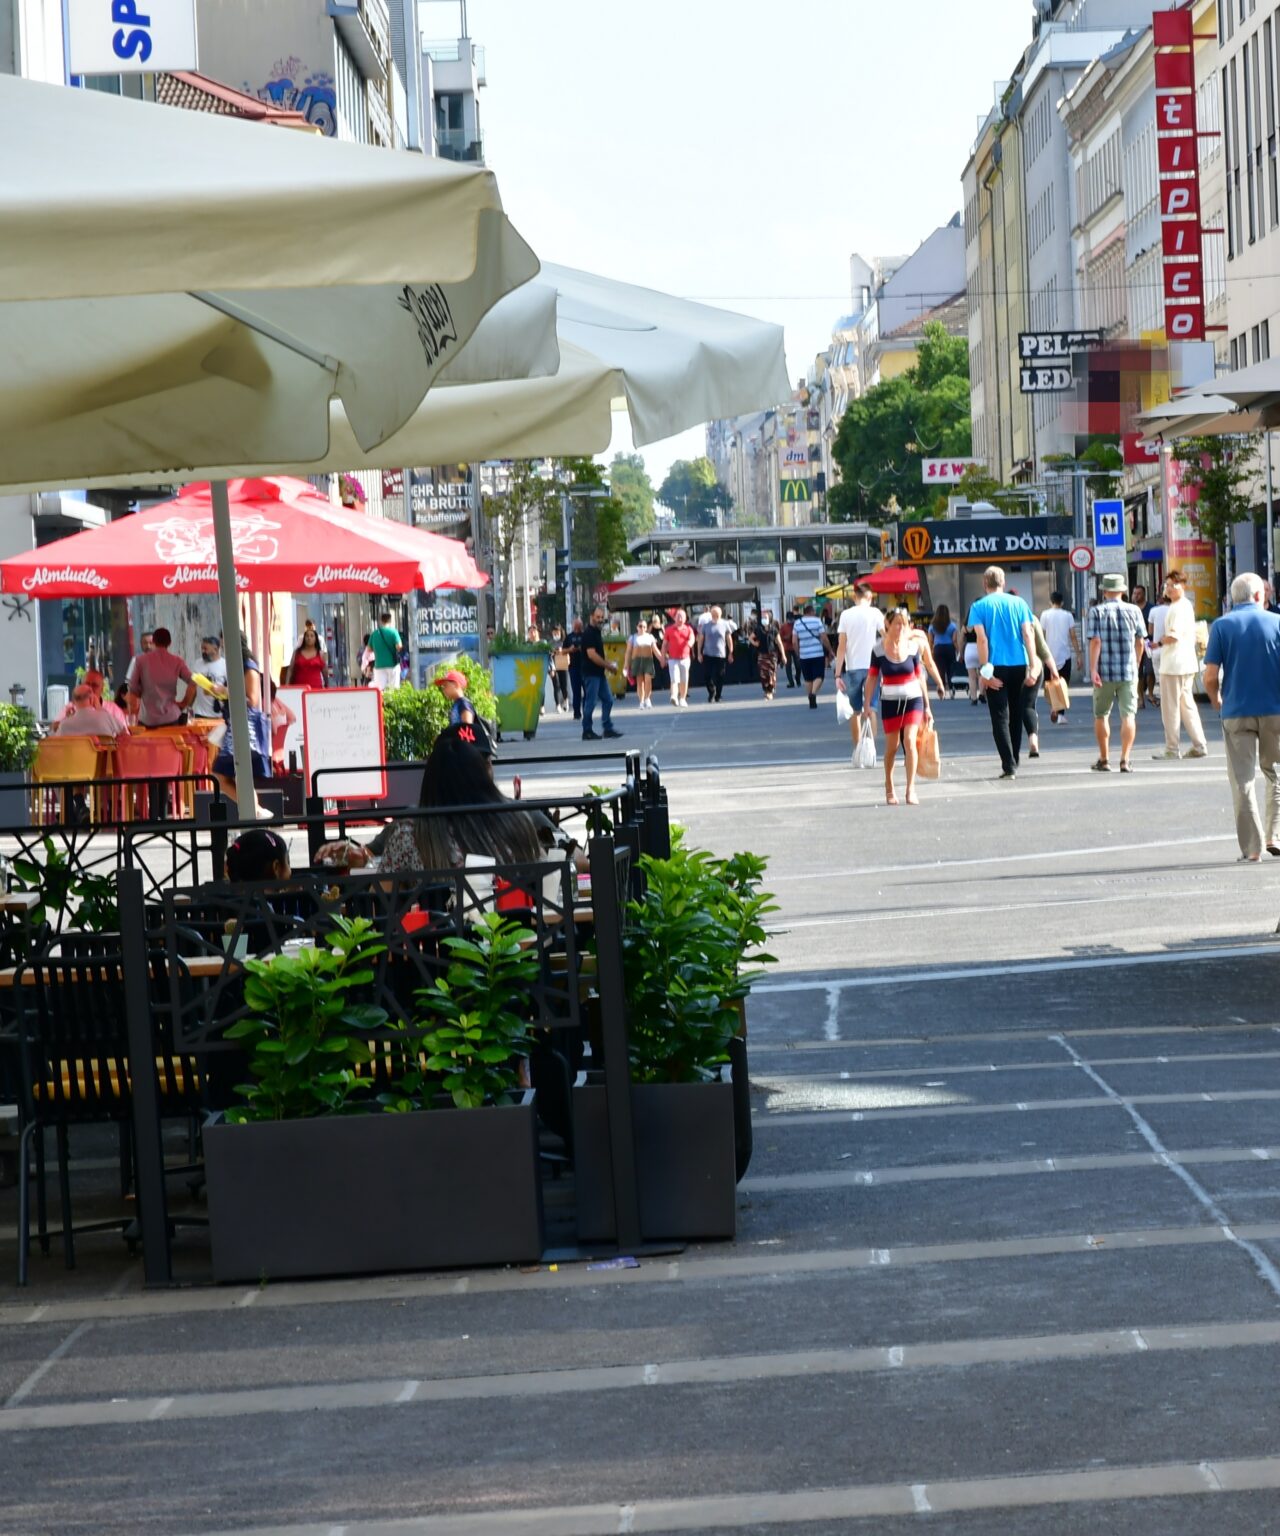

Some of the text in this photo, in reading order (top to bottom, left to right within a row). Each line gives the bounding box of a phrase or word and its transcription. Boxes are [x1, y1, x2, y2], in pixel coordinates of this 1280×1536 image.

[786, 450, 804, 461] dm
[22, 566, 109, 590] Almdudler
[303, 564, 391, 588] Almdudler
